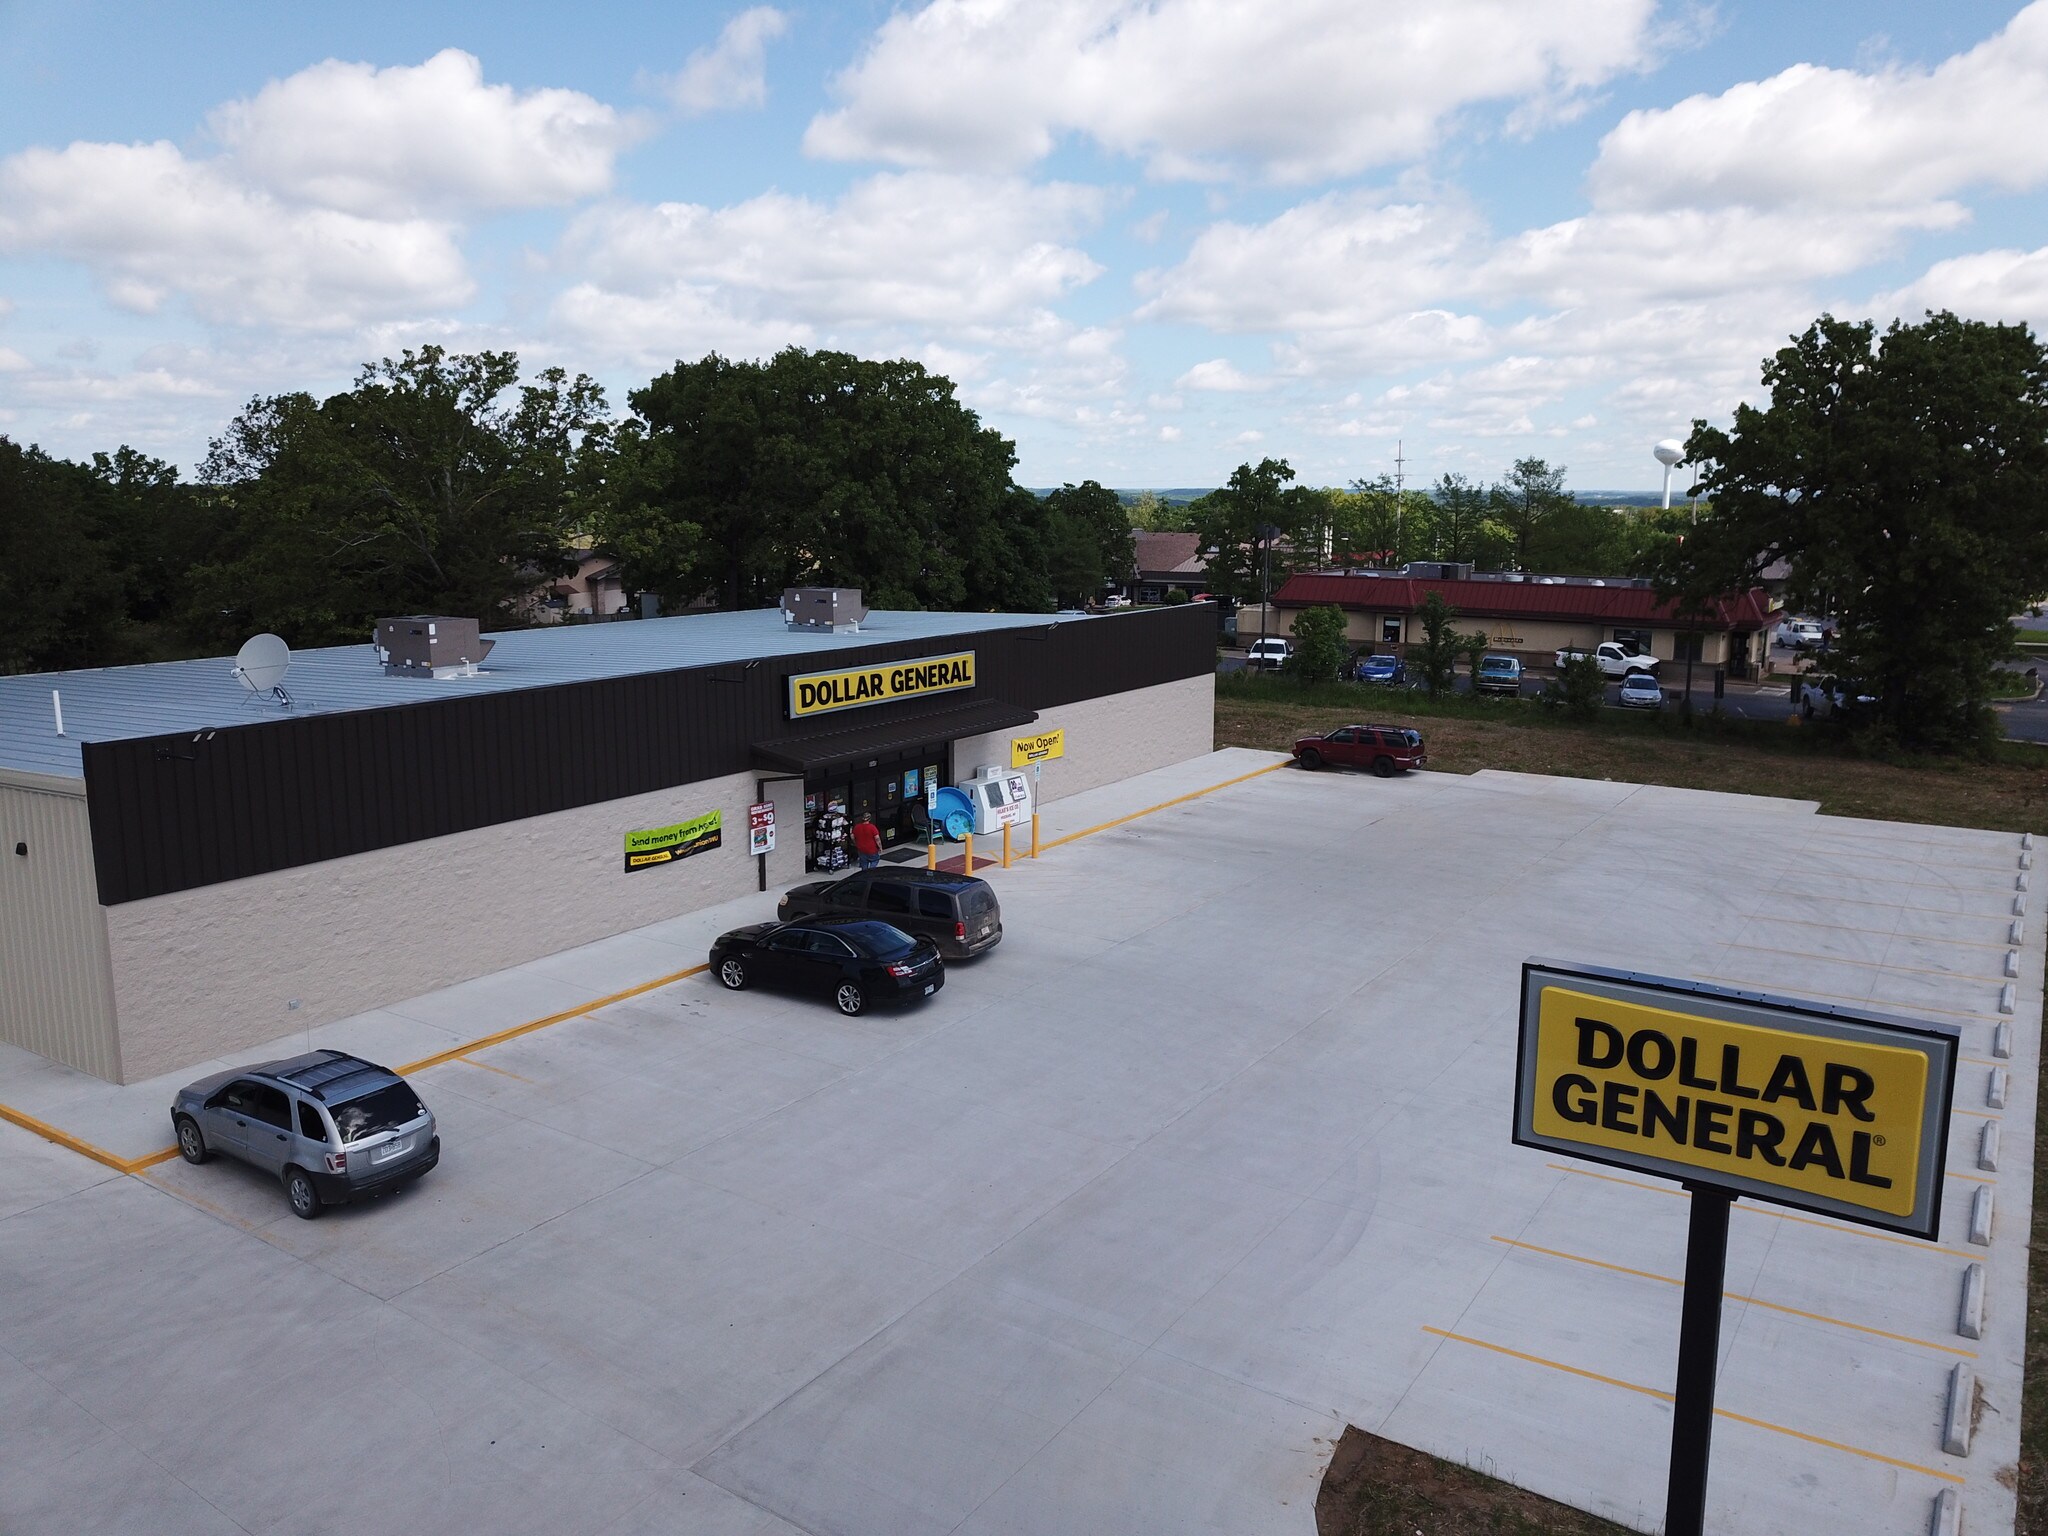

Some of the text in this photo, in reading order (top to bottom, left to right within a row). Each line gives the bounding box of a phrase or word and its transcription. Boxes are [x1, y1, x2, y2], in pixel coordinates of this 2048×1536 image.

[799, 660, 971, 708] DOLLAR GENERAL
[1017, 733, 1060, 752] Now Open!
[631, 817, 717, 846] Send money from he!
[752, 817, 757, 825] 3
[1552, 1017, 1892, 1189] DOLLAR GENERAL
